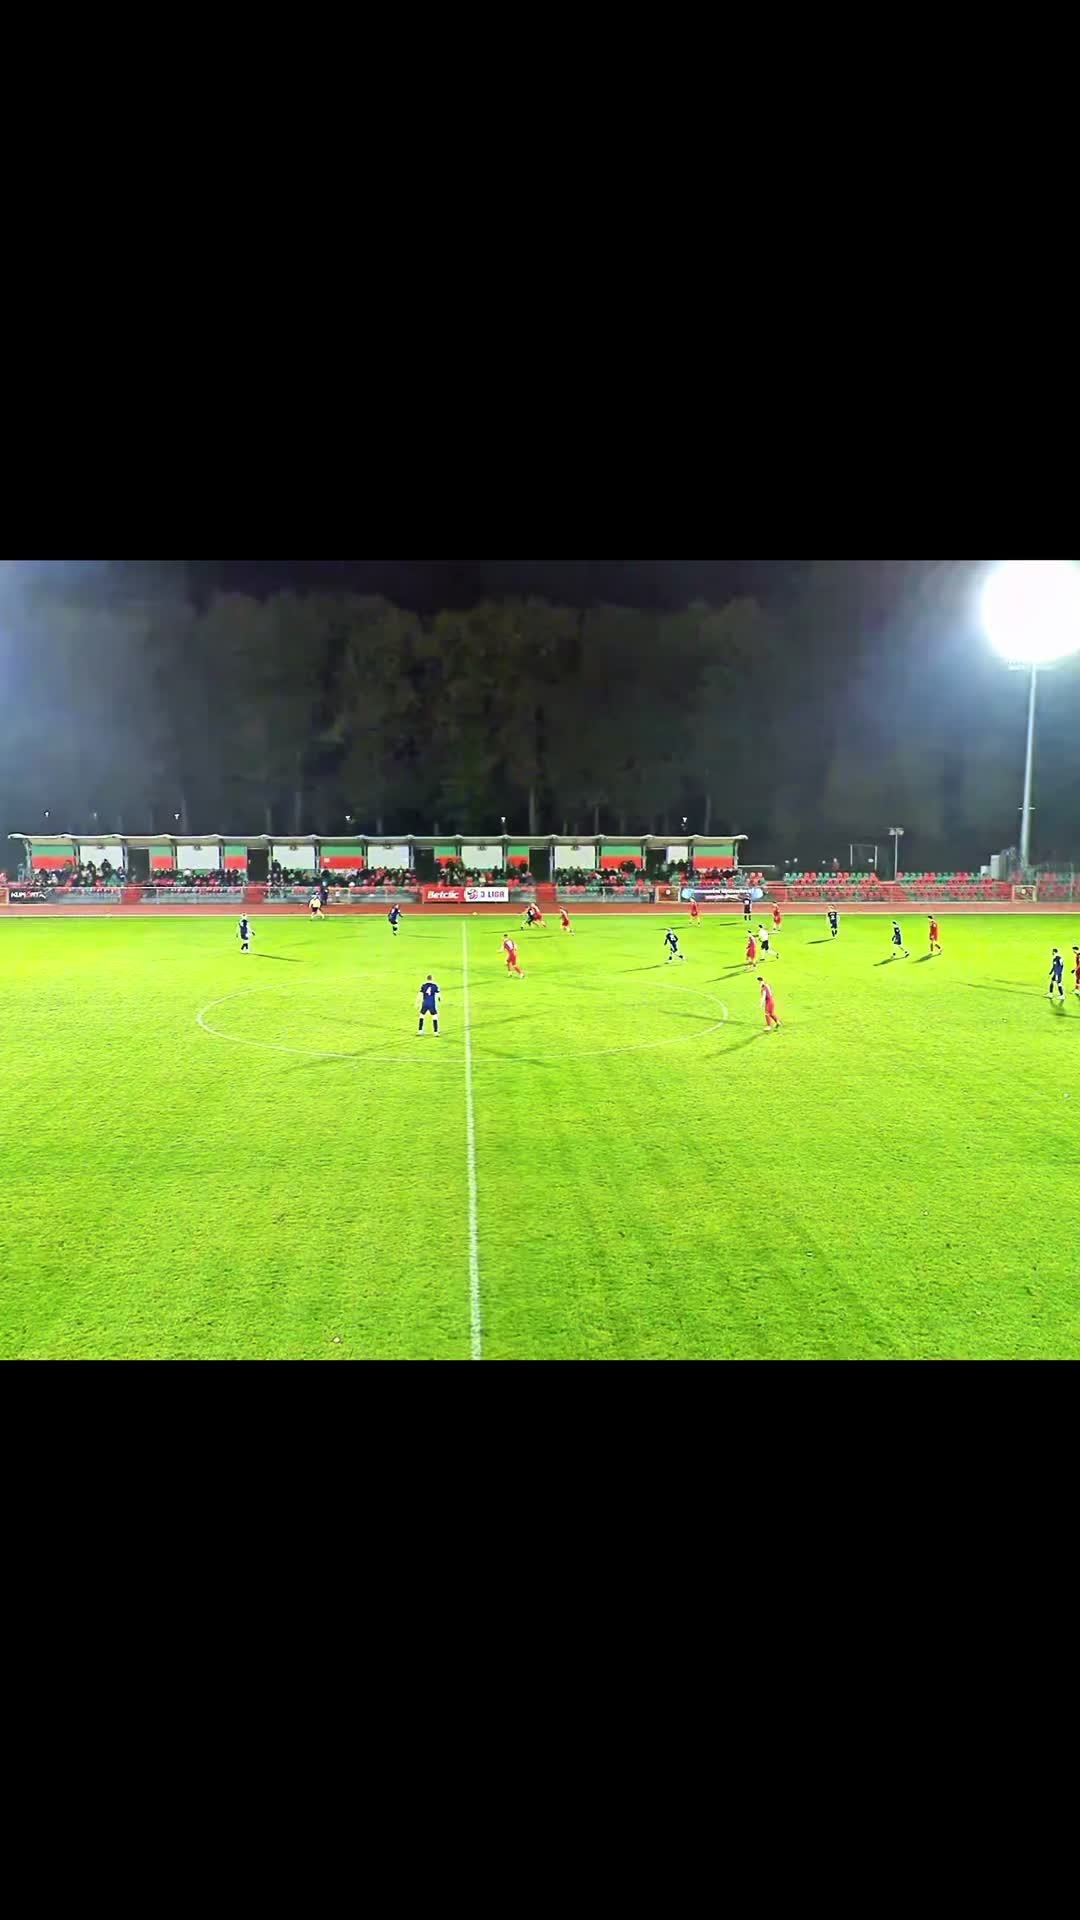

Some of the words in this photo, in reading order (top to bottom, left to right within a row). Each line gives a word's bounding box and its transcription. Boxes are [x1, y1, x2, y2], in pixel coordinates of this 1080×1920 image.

[427, 890, 460, 899] Betclic
[487, 890, 505, 898] LIGA
[425, 986, 432, 996] 4
